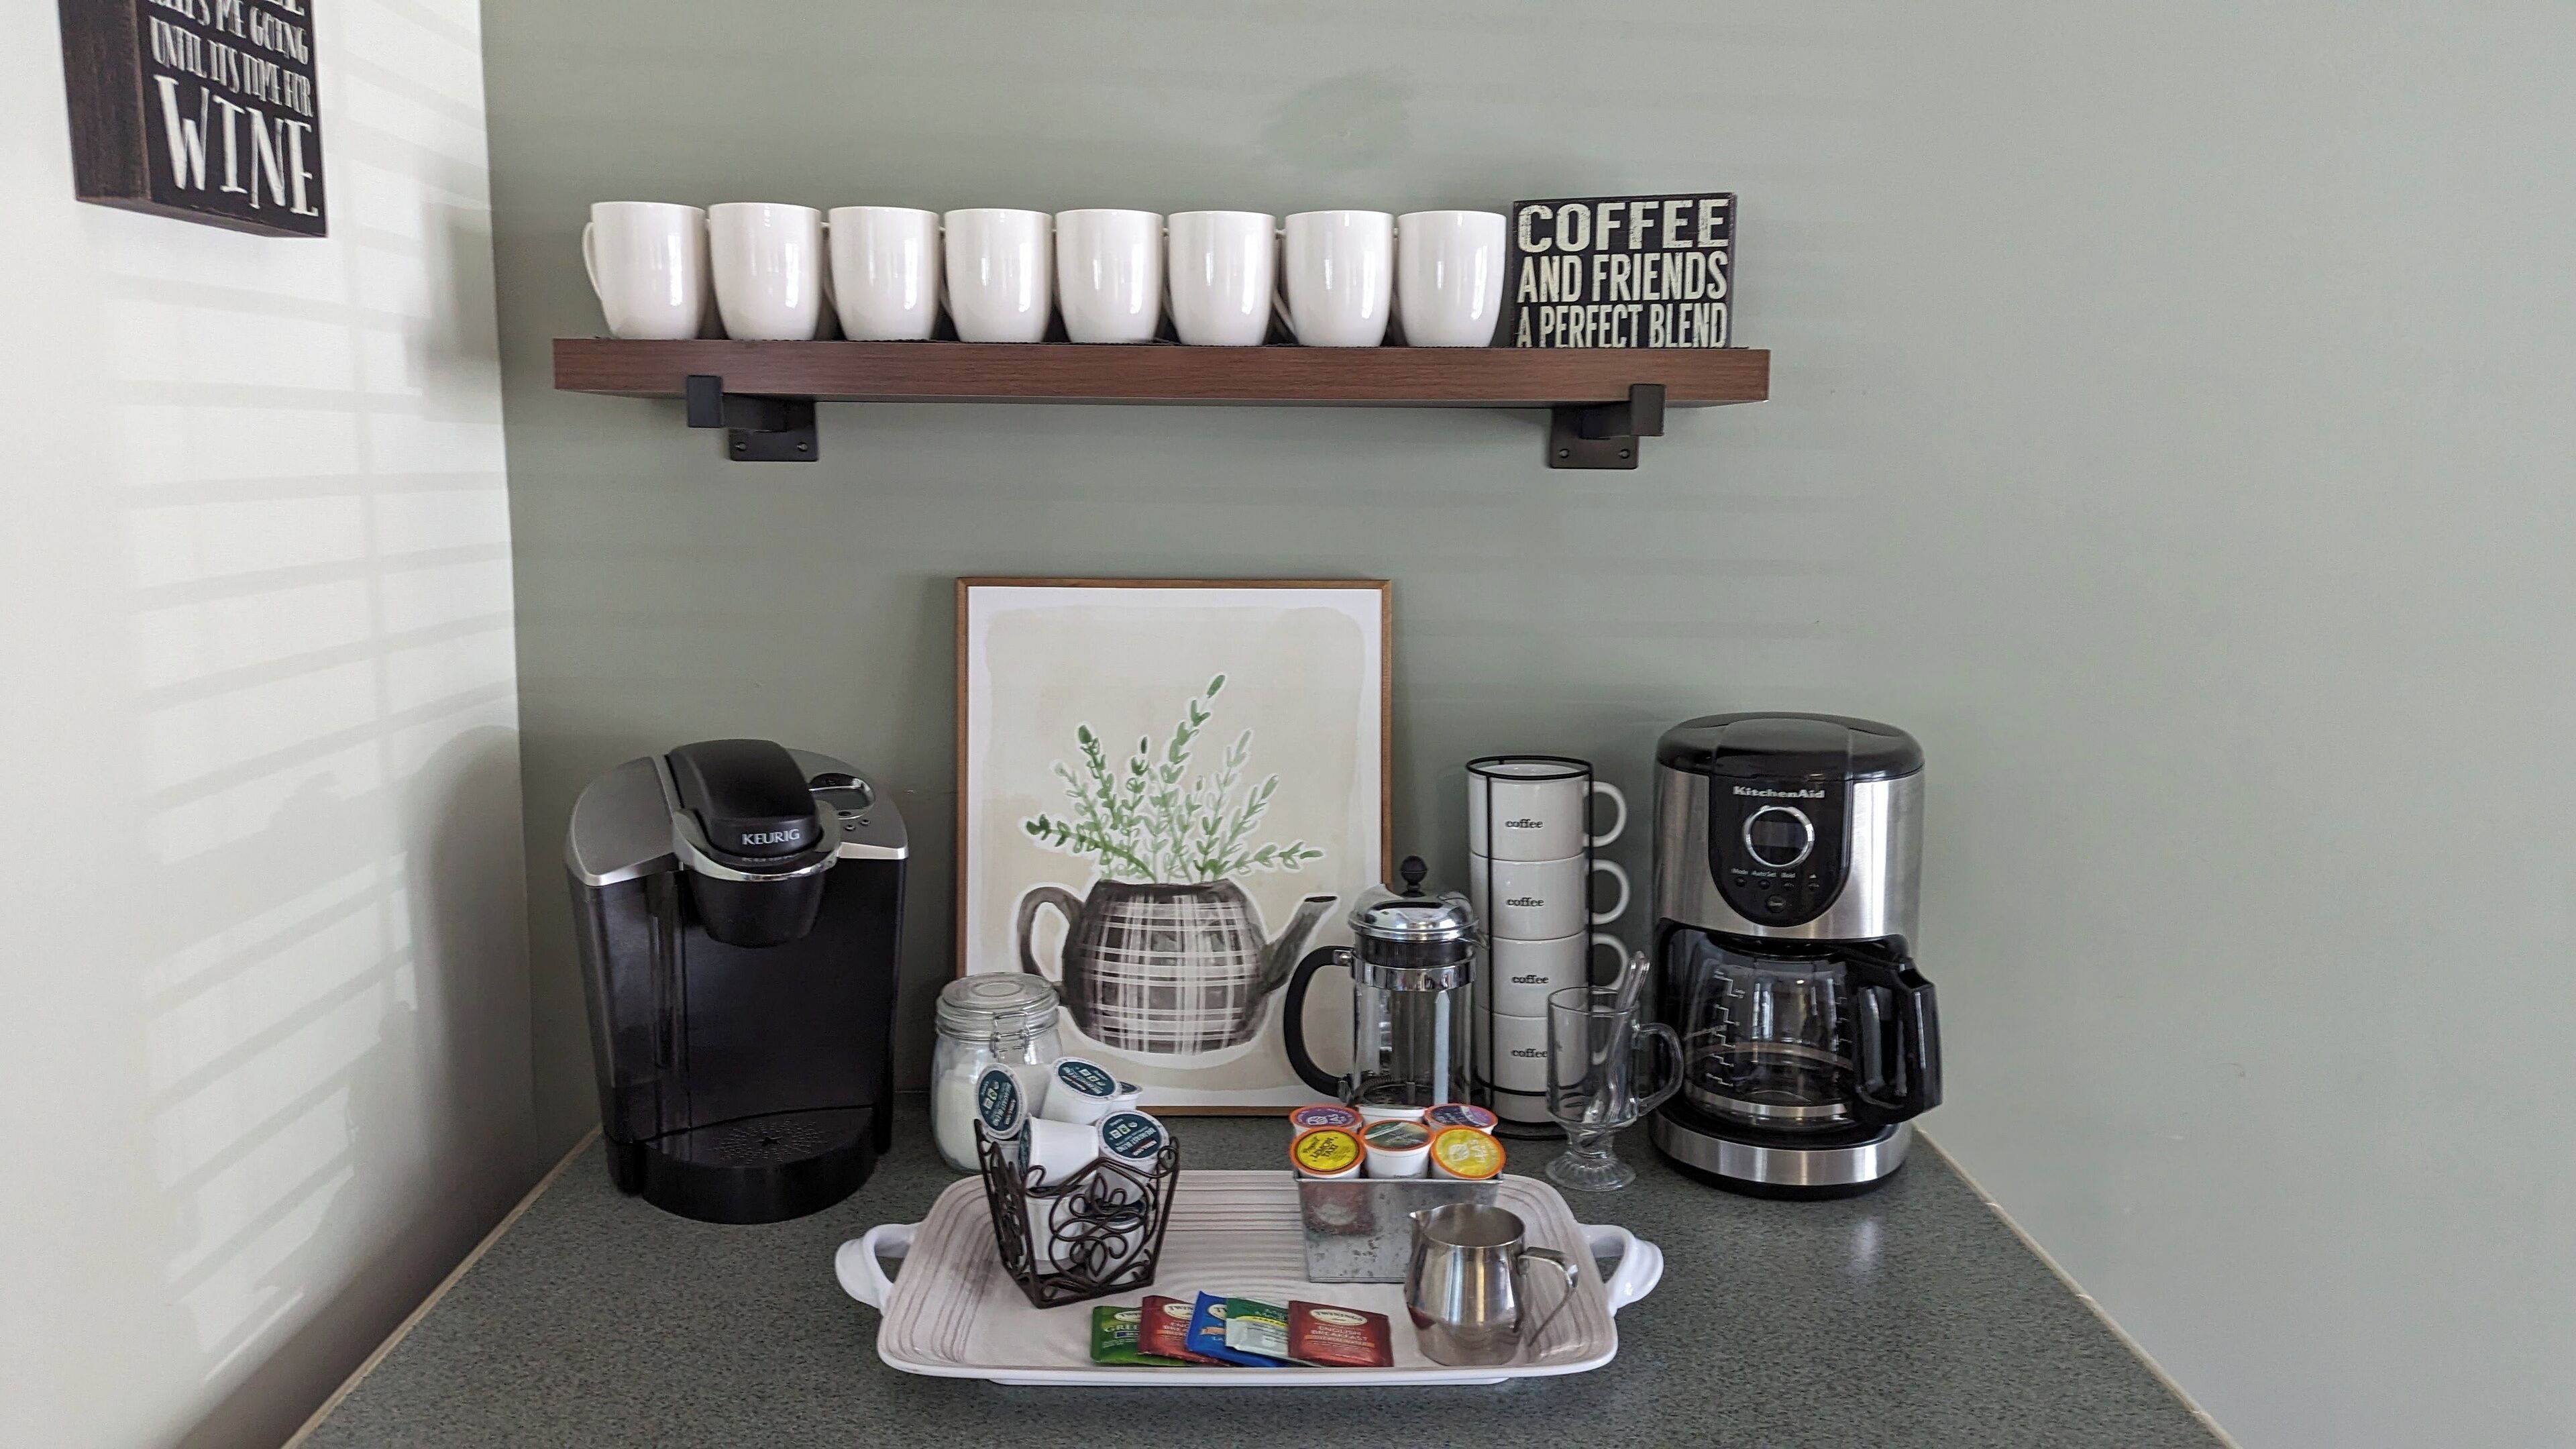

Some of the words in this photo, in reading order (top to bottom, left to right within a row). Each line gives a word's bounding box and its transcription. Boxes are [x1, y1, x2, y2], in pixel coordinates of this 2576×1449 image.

[249, 6, 309, 64] GOING
[149, 15, 207, 78] UNTIL
[239, 52, 283, 106] TIME
[282, 69, 314, 118] FOR
[153, 74, 319, 217] WINE
[1517, 199, 1729, 253] COFFEE
[1517, 255, 1582, 303] AND
[1592, 250, 1729, 301] FRIENDS
[1517, 306, 1533, 347] A
[1539, 304, 1644, 347] PERFECT
[1648, 302, 1728, 347] BLEND
[1733, 786, 1825, 798] KitchenAid
[1505, 818, 1544, 828] coffee
[741, 828, 800, 845] KEURIG
[1506, 896, 1545, 907] coffee
[1511, 974, 1549, 984] coffee
[1511, 1048, 1548, 1058] coffee
[1104, 1324, 1140, 1332] GREE
